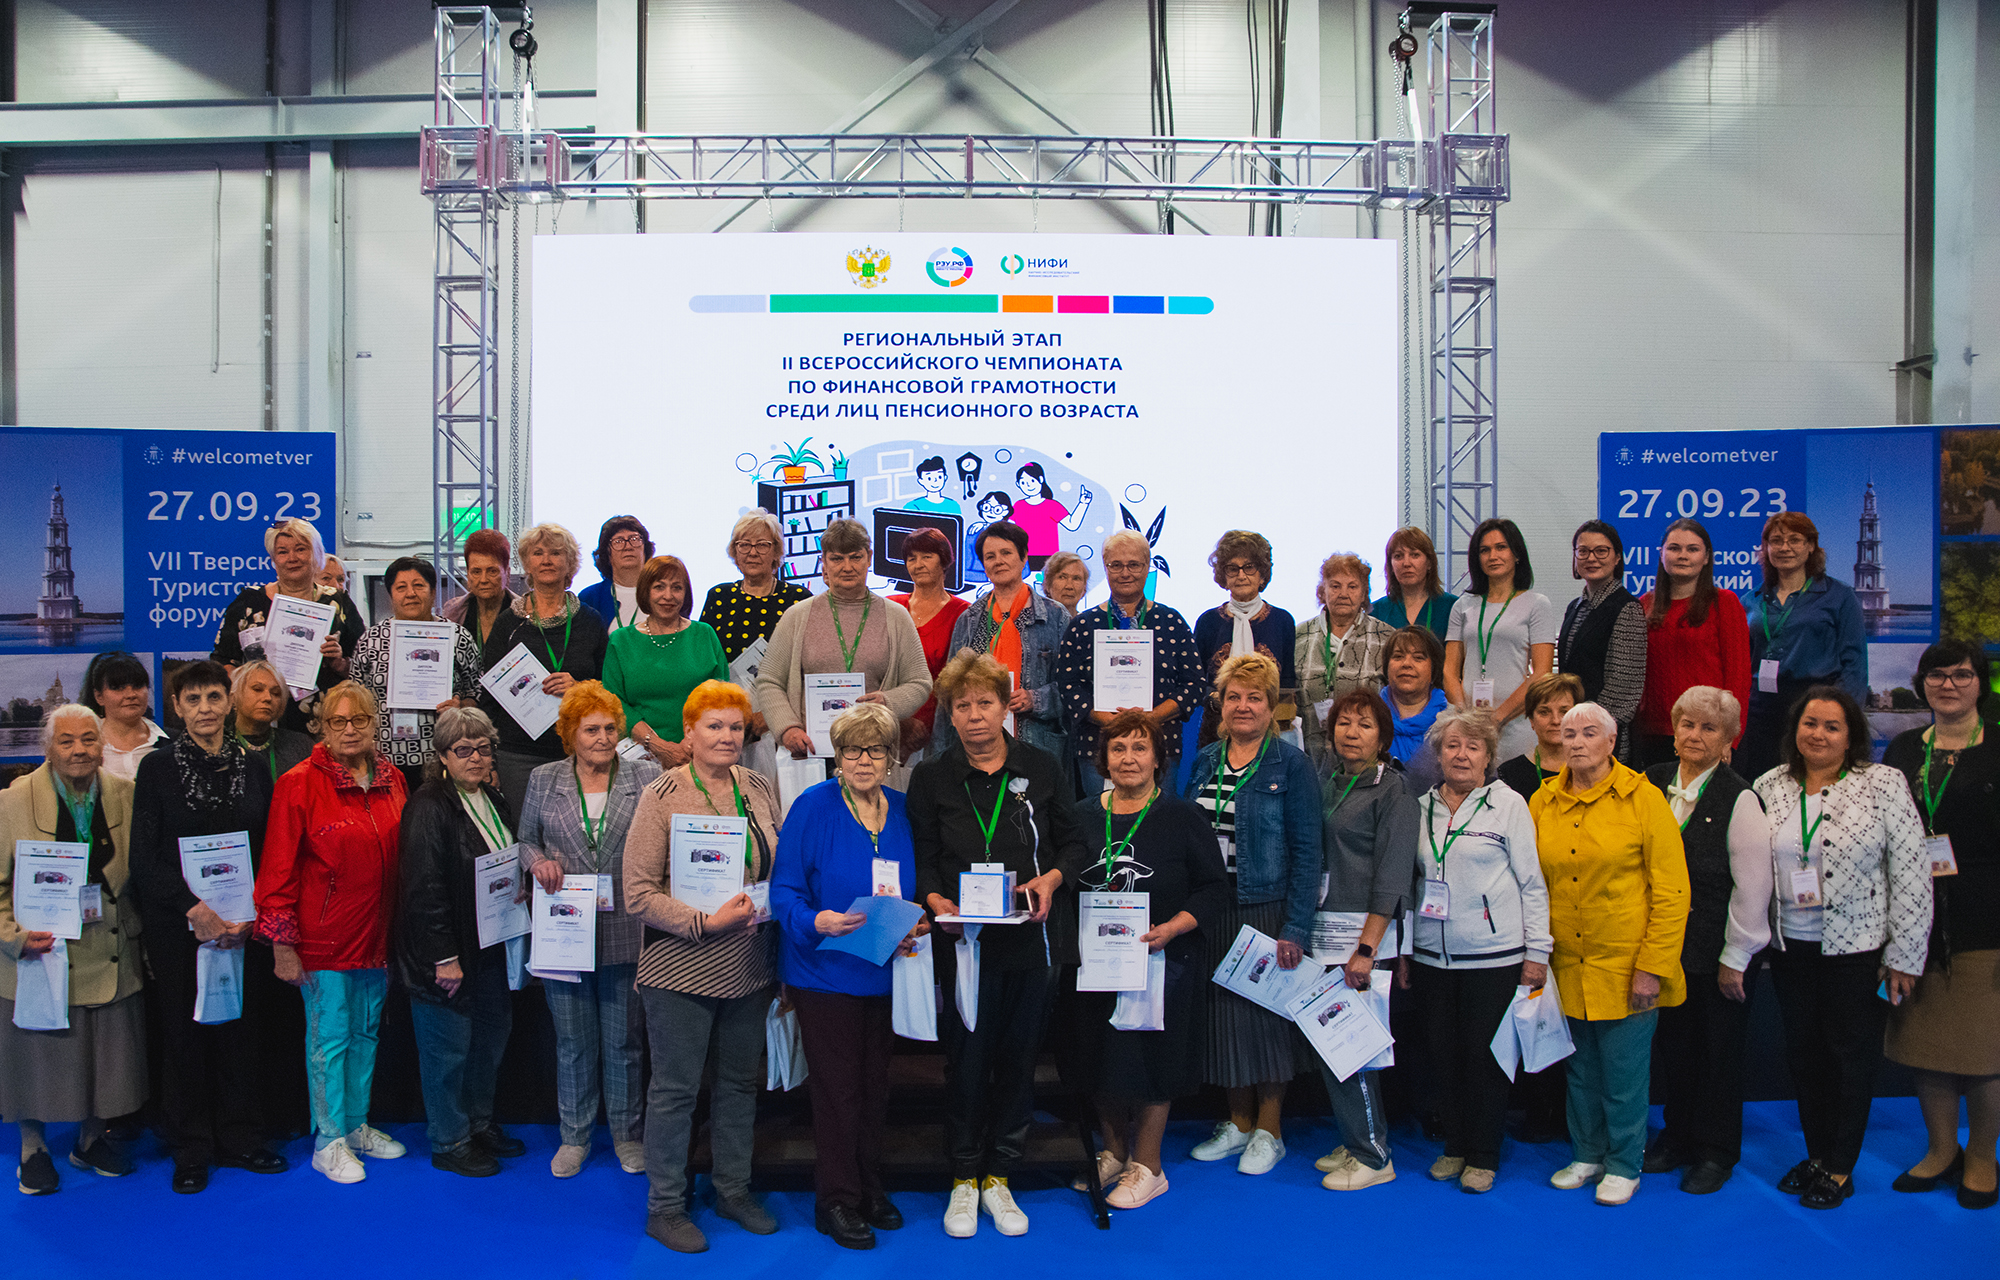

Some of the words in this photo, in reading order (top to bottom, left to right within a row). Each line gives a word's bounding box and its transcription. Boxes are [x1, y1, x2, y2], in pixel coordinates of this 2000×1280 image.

[1027, 257, 1068, 269] НИФИ
[843, 329, 1004, 346] РЕГИОНАЛЬНЫЙ
[1012, 332, 1062, 346] ЭТАП
[782, 356, 793, 370] II
[800, 353, 979, 370] ВСЕРОССИЙСКОГО
[985, 356, 1123, 370] ЧЕМПИОНАТА
[788, 380, 816, 394] ПО
[823, 376, 963, 394] ФИНАНСОВОЙ
[971, 380, 1116, 394] ГРАМОТНОСТИ
[765, 403, 829, 420] СРЕДИ
[835, 403, 879, 420] ЛИЦ
[885, 403, 1033, 418] ПЕНСИОННОГО
[1040, 403, 1140, 418] ВОЗРАСТА
[172, 448, 313, 465] #welcometver
[1640, 447, 1778, 464] #welcometver
[147, 490, 322, 521] 27.09.23
[1618, 487, 1788, 519] 27.09.23
[148, 551, 181, 571] VII
